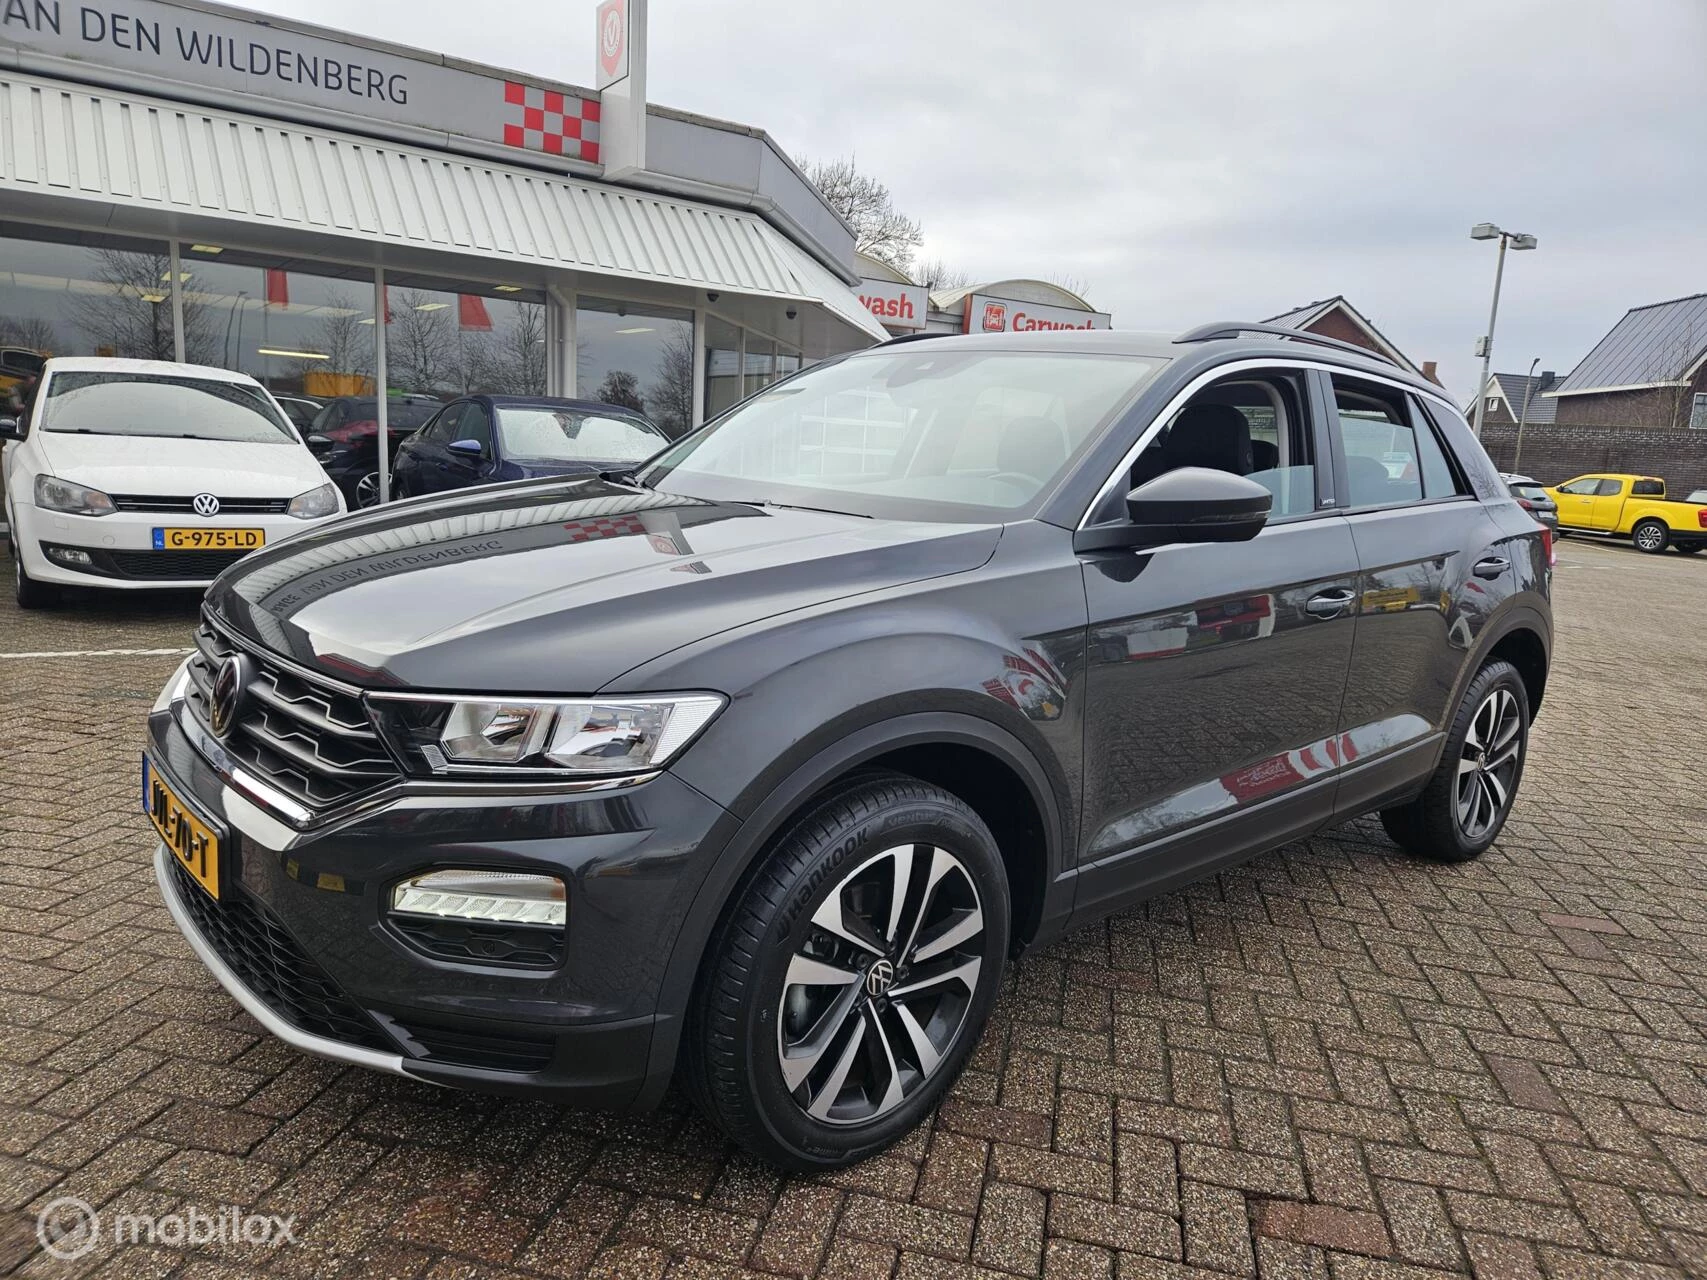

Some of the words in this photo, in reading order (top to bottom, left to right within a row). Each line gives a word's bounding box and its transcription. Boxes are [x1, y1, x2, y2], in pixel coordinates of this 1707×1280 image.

[80, 6, 161, 56] DEN
[176, 26, 408, 105] WILDENBERG
[1012, 312, 1096, 332] Carw
[171, 531, 257, 546] G-975-LD
